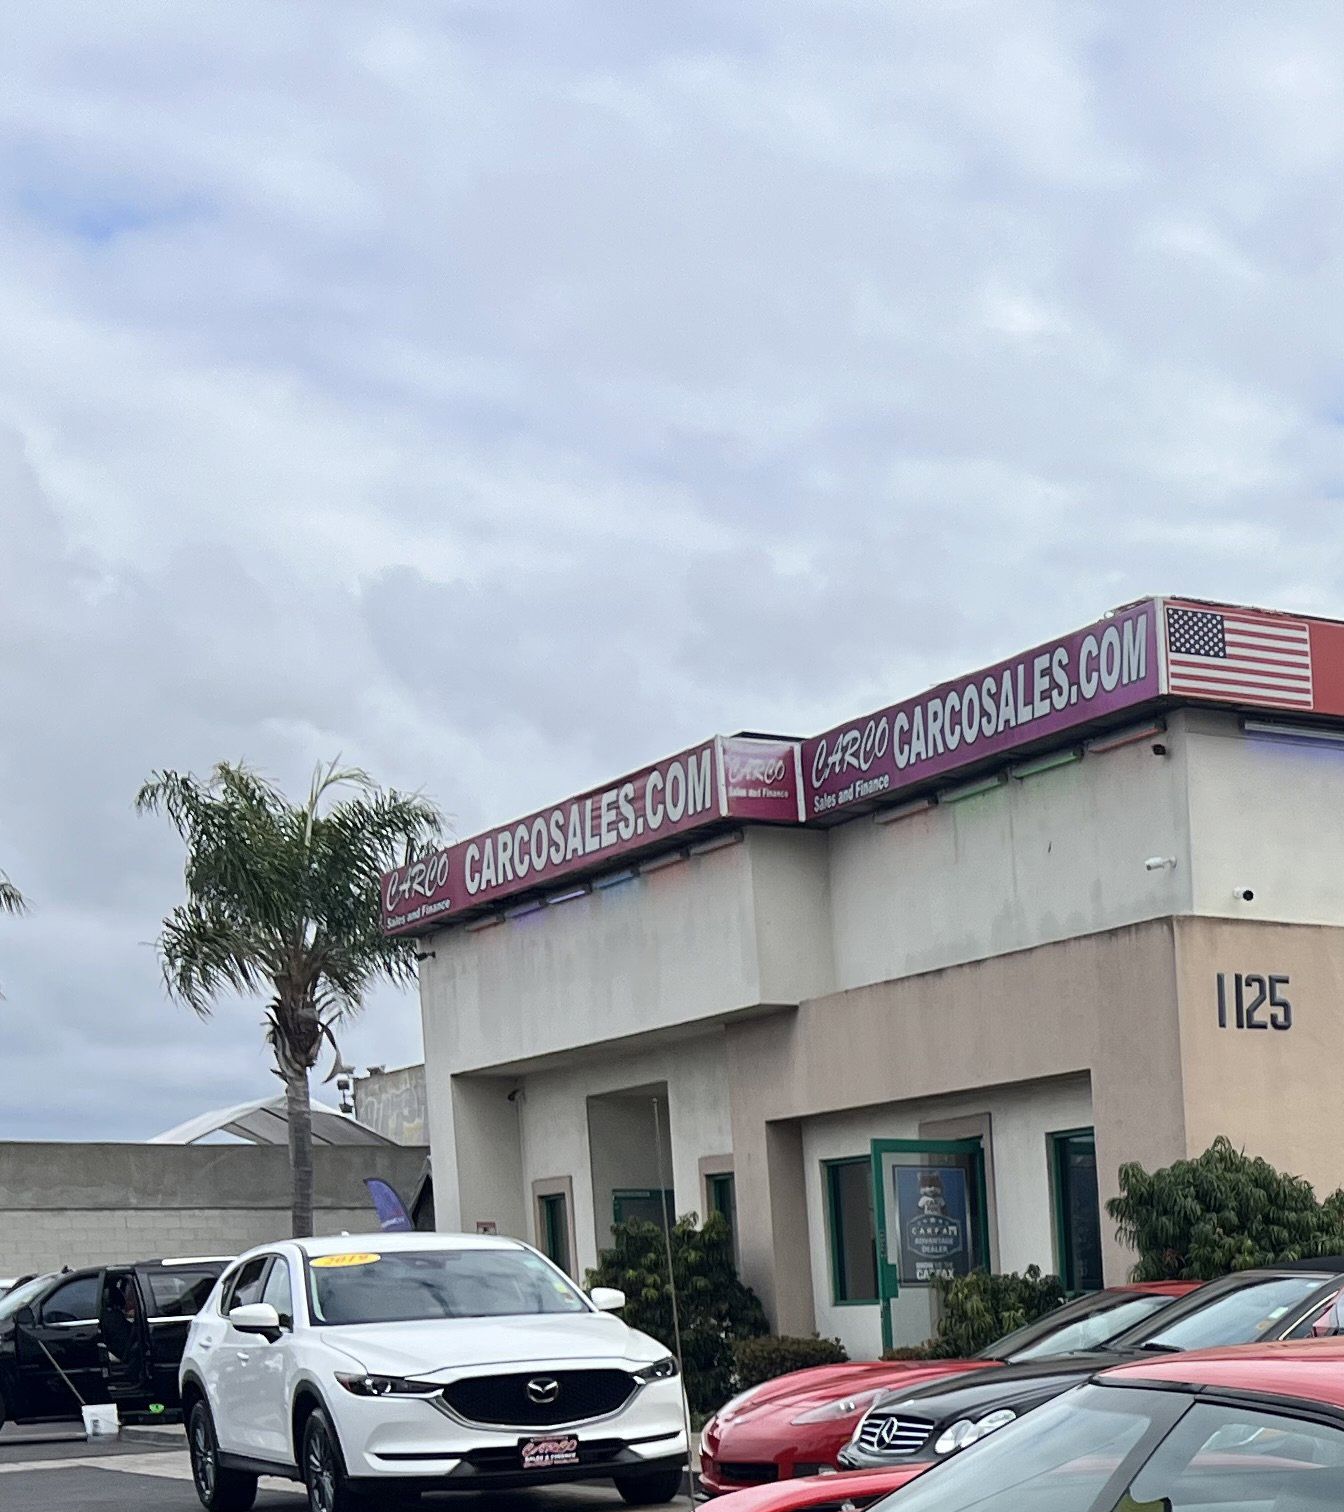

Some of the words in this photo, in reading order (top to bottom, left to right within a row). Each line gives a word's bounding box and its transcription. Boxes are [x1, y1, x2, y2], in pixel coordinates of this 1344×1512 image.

[893, 613, 1148, 770] CARCOSALES.COM
[727, 758, 786, 784] CARCO
[812, 716, 889, 788] CARCO
[465, 748, 713, 895] CARCOSALES.COM
[762, 788, 789, 798] Finance
[813, 792, 837, 812] Sales
[838, 782, 854, 804] and
[855, 774, 890, 798] Finance
[386, 852, 449, 912] CARCO
[1217, 973, 1292, 1030] 1125
